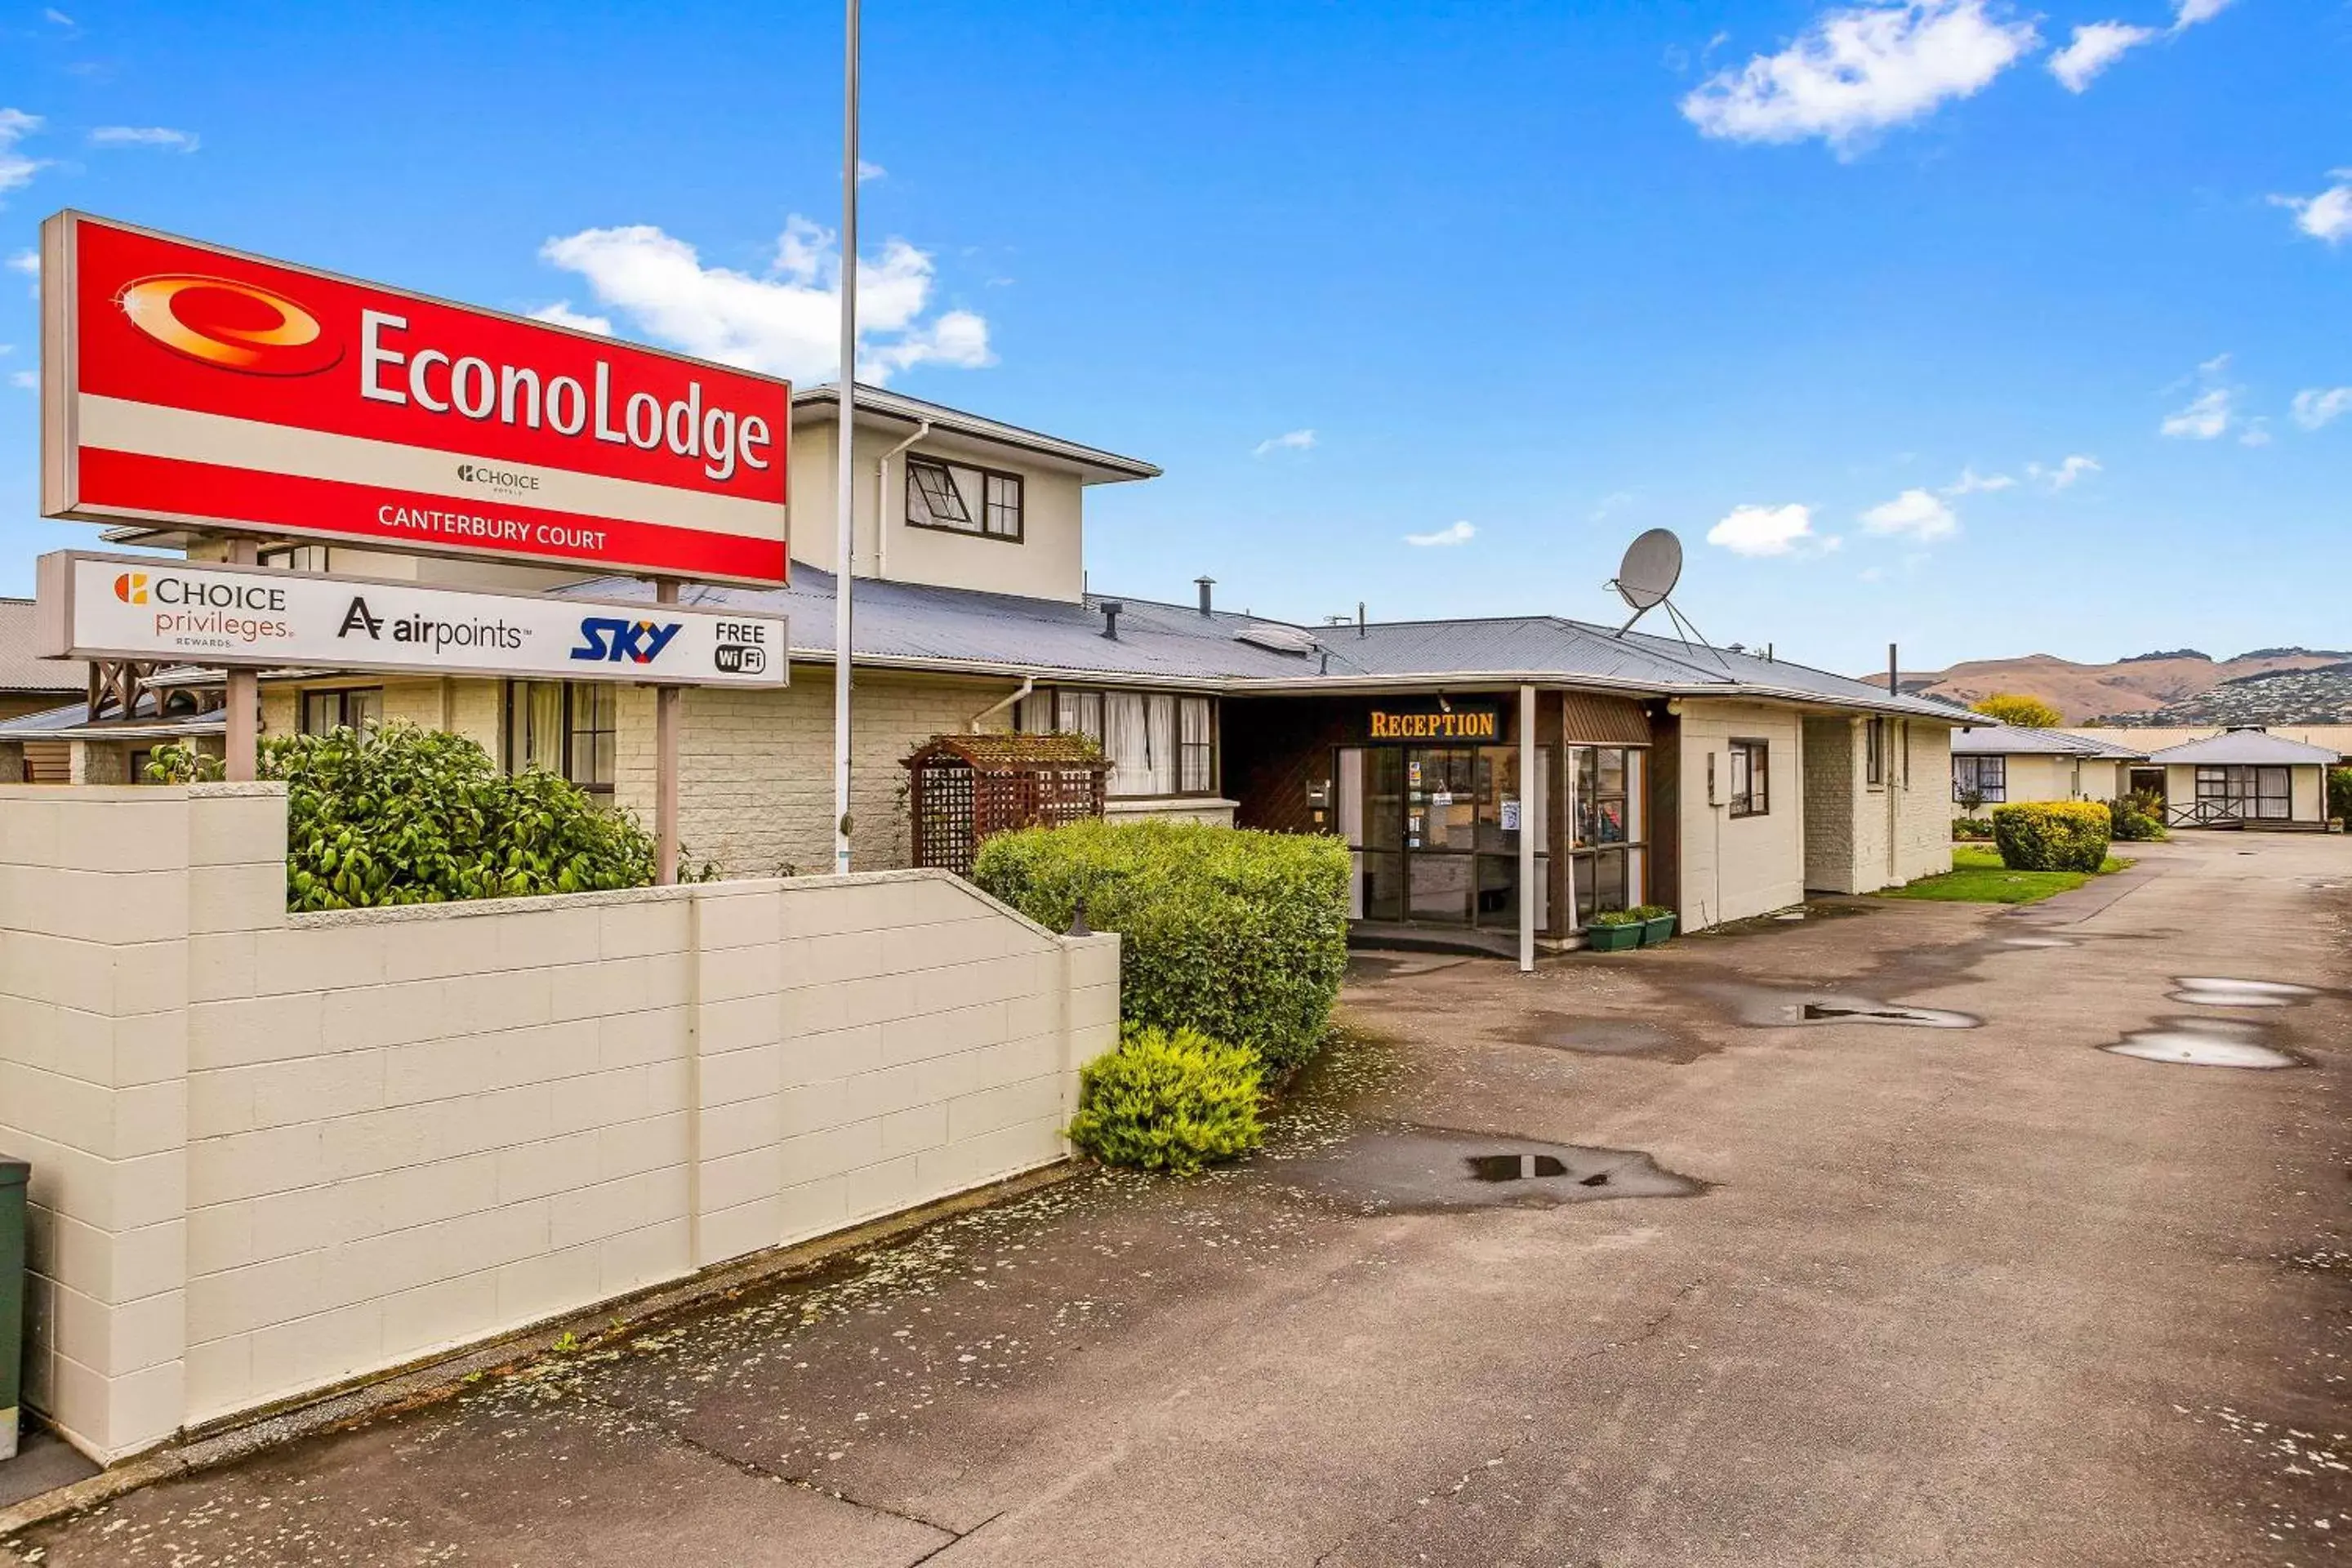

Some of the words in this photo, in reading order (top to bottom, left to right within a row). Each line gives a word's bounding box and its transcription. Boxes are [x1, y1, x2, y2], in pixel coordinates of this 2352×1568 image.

[360, 308, 772, 480] EconoLodge
[476, 468, 539, 490] CHOICE
[378, 505, 530, 541] CANTERBURY
[537, 525, 607, 550] COURT
[155, 578, 286, 611] CHOICE
[570, 617, 683, 663] SKY
[716, 622, 764, 644] FREE
